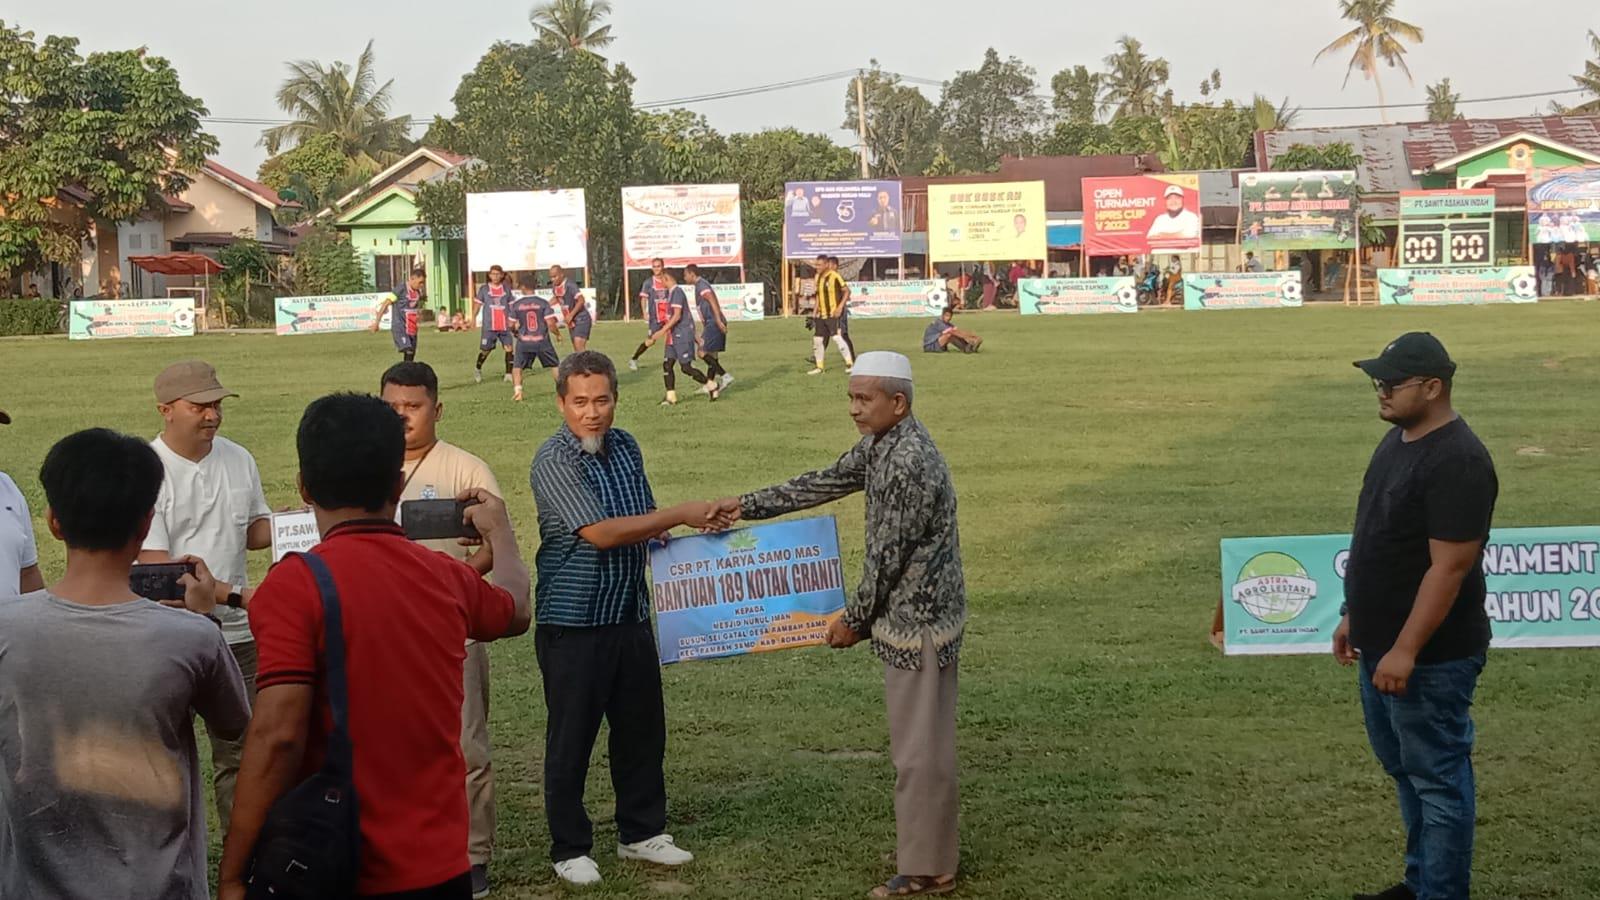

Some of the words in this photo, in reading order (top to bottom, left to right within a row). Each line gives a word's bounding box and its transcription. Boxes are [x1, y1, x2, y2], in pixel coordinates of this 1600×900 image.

[1094, 188, 1123, 199] OPEN
[1094, 197, 1156, 209] TURNAMENT
[1424, 199, 1443, 208] SAWIT
[1470, 198, 1489, 207] INDAH
[1123, 209, 1146, 219] CUP
[1095, 221, 1104, 231] V
[1411, 268, 1456, 276] HPRS
[670, 563, 693, 576] CSR
[696, 560, 712, 573] PT.
[716, 554, 755, 569] KARYA
[758, 549, 792, 563] SAMO
[795, 545, 820, 559] MAS
[1482, 541, 1600, 576] NAMENT
[655, 577, 717, 612] BANTUAN
[719, 572, 744, 603] 189
[749, 566, 790, 600] KOTAK
[792, 558, 841, 594] GRANIT
[1257, 577, 1289, 585] ASTRA
[1238, 585, 1268, 599] AGRO
[1270, 584, 1311, 593] LESTARI
[1484, 588, 1562, 622] AHUN
[1568, 586, 1600, 621] 20
[735, 606, 764, 616] KEPADA
[713, 619, 742, 630] MESJID
[743, 616, 770, 626] NURUL
[771, 613, 791, 622] IMAN
[709, 633, 721, 641] SEI
[723, 631, 747, 640] GATAL
[749, 627, 769, 636] DESA
[771, 622, 804, 633] RAMBAH
[806, 619, 828, 628] SAMO
[700, 645, 732, 654] RAMBAH
[735, 640, 756, 650] SAMO
[781, 634, 807, 643] ROKAN
